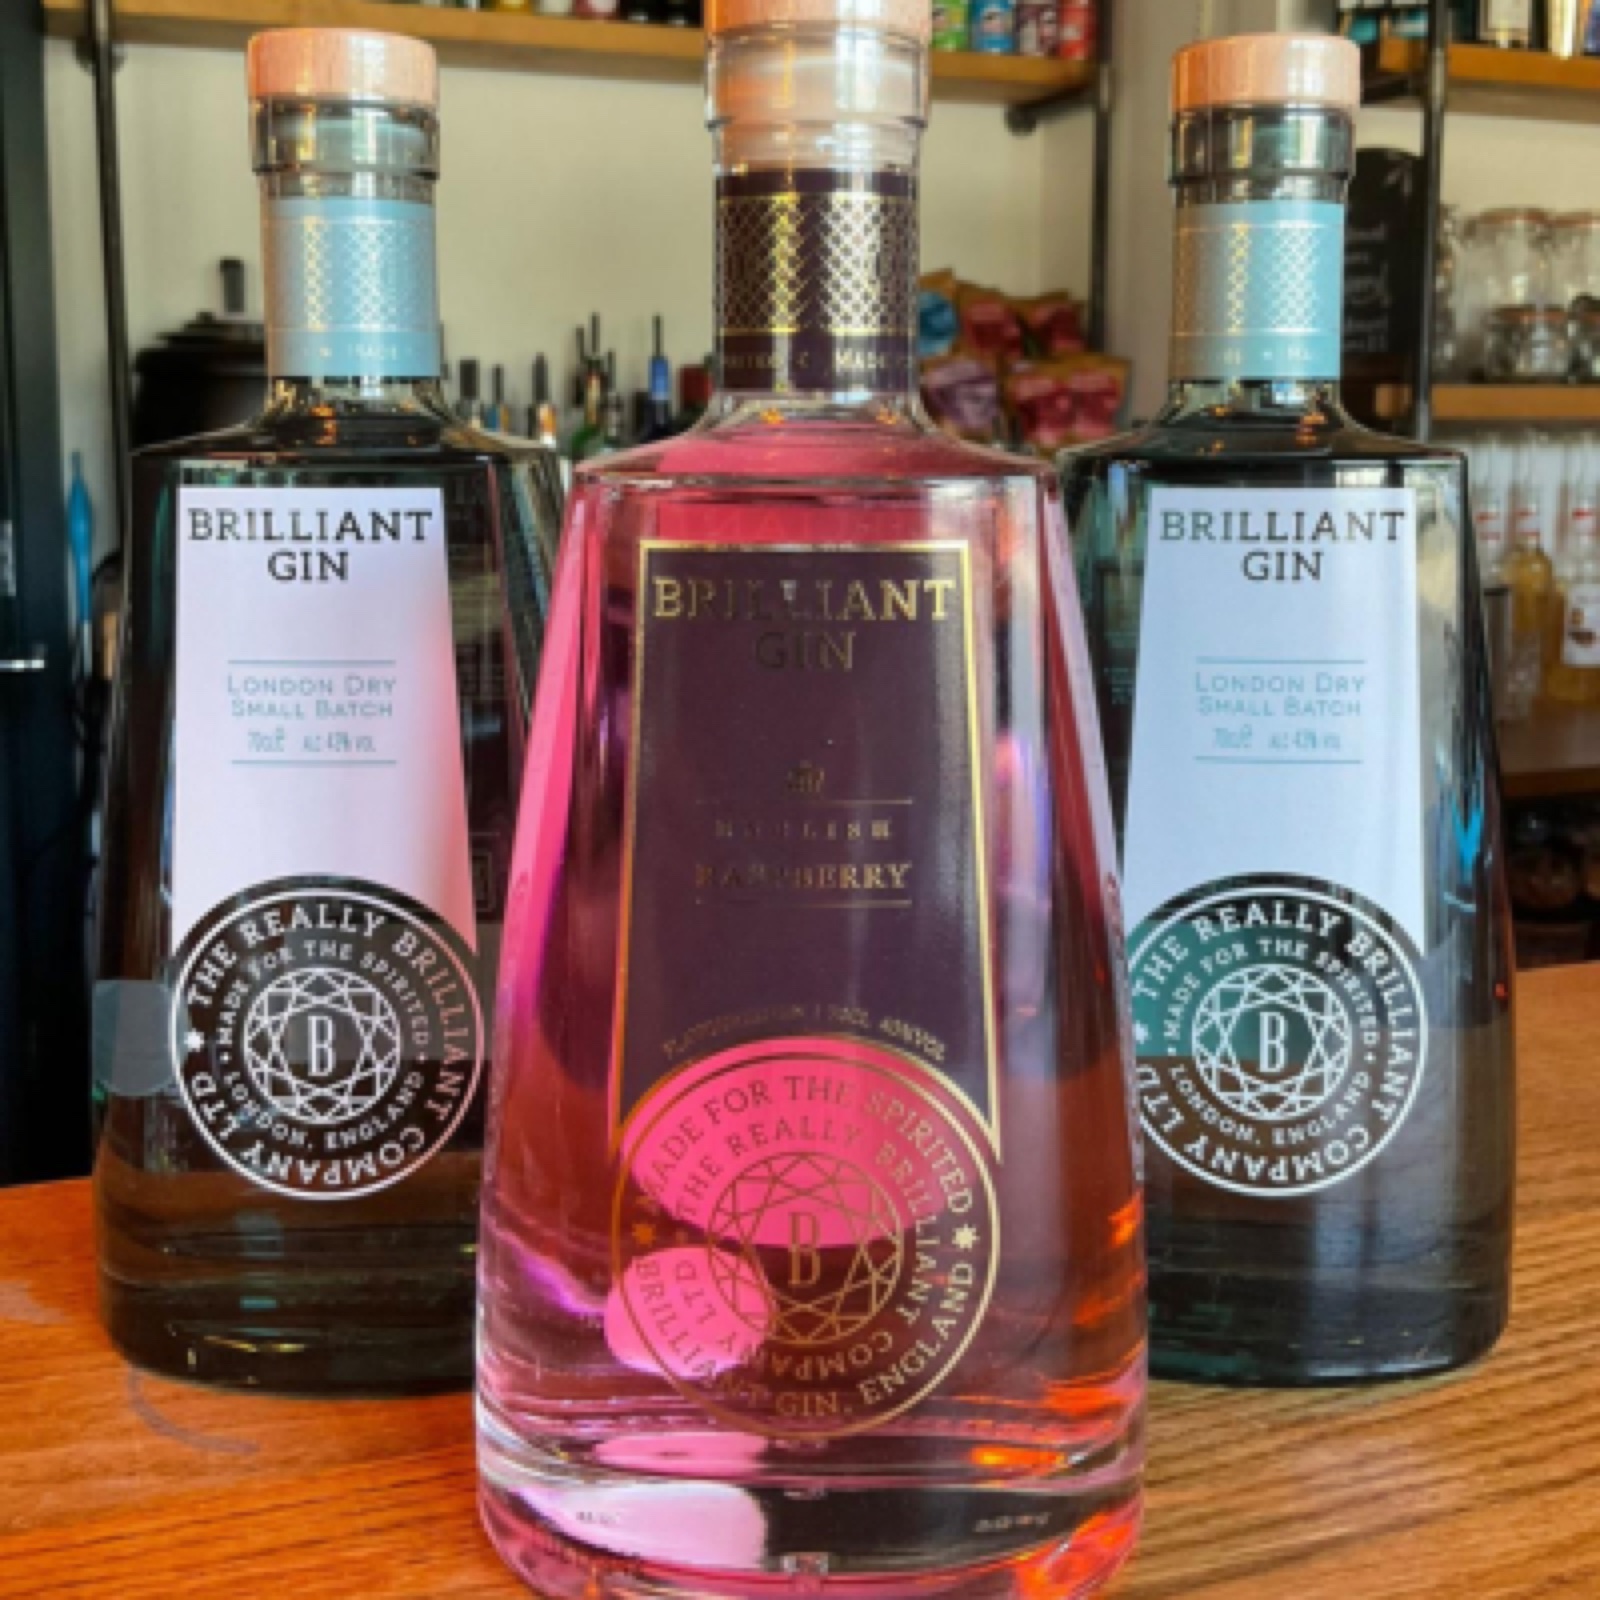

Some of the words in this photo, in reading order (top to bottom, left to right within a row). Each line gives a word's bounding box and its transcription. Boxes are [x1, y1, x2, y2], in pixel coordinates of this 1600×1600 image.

[187, 507, 433, 541] BRILLIANT
[1160, 509, 1405, 542] BRILLIANT
[266, 550, 350, 582] GIN
[1240, 550, 1324, 582] GIN
[652, 575, 957, 621] BRILLIANT
[754, 630, 857, 672] GIN
[695, 861, 912, 890] RASPBERRY
[239, 902, 387, 949] REALLY
[303, 940, 354, 962] THE
[1191, 900, 1342, 943] REALLY
[1256, 937, 1310, 961] THE
[188, 941, 238, 1006] THE
[1131, 935, 1189, 1002] THE
[308, 1014, 334, 1077] B
[391, 929, 469, 1122] BRILLIANT
[1260, 1011, 1288, 1074] B
[1345, 930, 1415, 1122] BRILLIANT
[191, 1071, 241, 1139] LTD
[240, 1125, 426, 1186] COMPANY
[702, 1080, 774, 1127] FOR
[783, 1075, 856, 1107] THE
[865, 1089, 974, 1214] SPIRITED
[725, 1115, 863, 1161] REALLY
[1183, 1125, 1370, 1182] COMPANY
[674, 1154, 725, 1219] THE
[788, 1211, 822, 1288] B
[876, 1140, 941, 1327] BRILLIANT
[674, 1258, 718, 1327] LTD
[856, 1261, 975, 1407] ENGLAND
